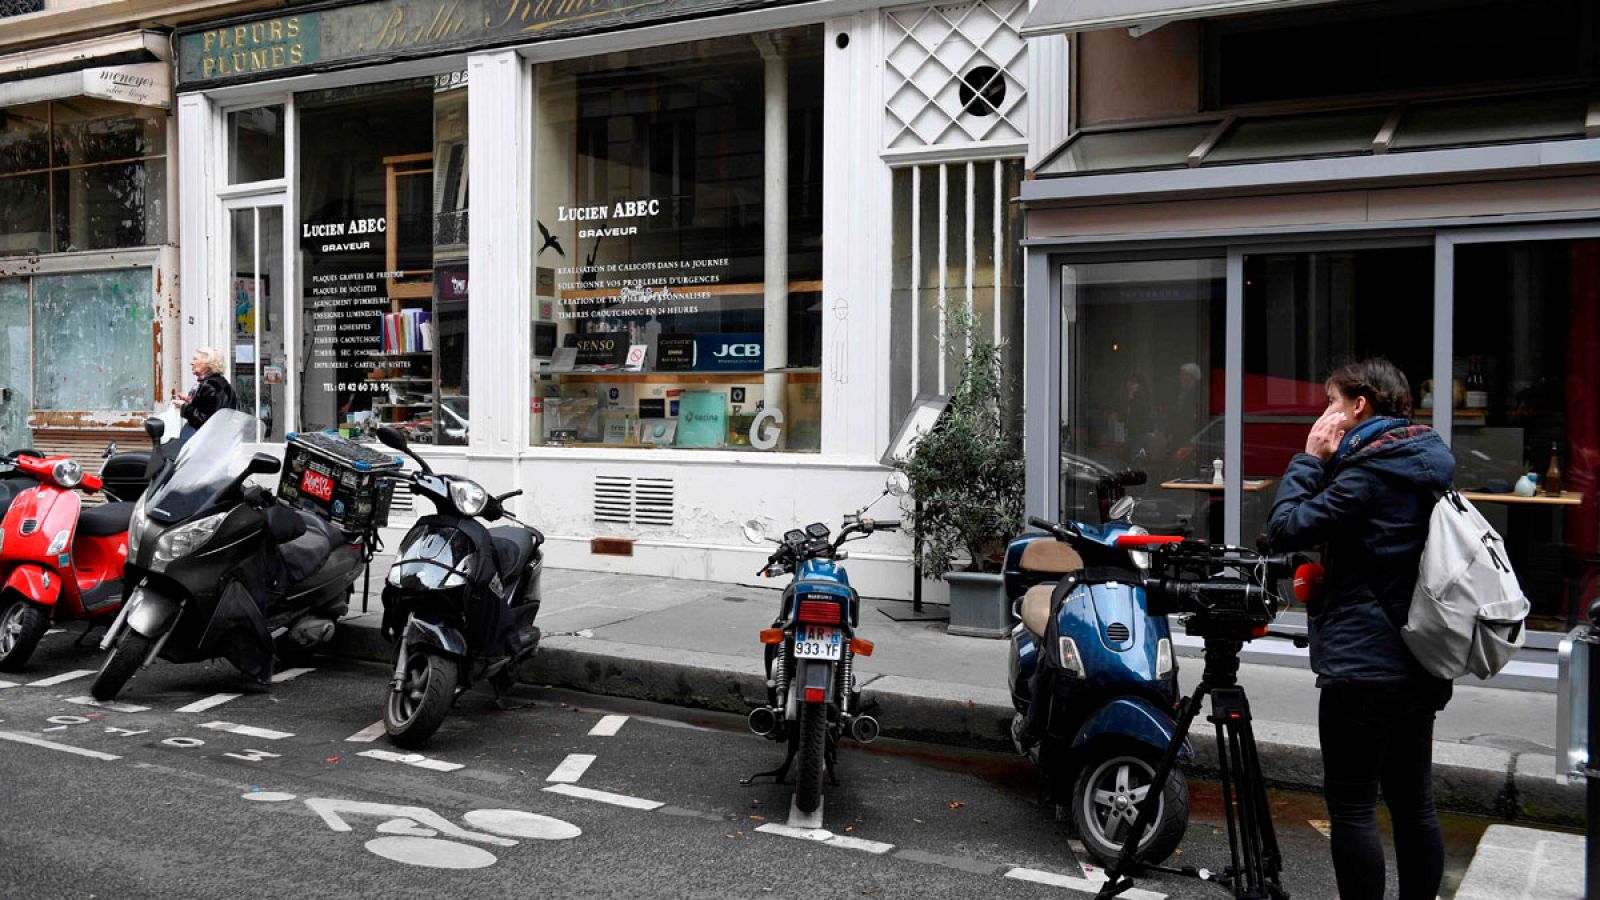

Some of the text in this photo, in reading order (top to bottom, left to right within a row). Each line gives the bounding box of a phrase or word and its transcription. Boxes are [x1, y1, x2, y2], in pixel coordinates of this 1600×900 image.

[204, 16, 300, 51] FLEURS
[203, 44, 304, 79] PLUMES
[612, 199, 660, 218] ABEC
[348, 218, 386, 234] ABEC
[578, 226, 638, 239] GRAVEUR
[322, 241, 370, 252] GRAVEUR
[606, 264, 617, 272] DE
[618, 262, 656, 271] CALICOTS
[657, 260, 678, 269] DANS
[680, 260, 690, 268] LA
[366, 272, 375, 280] DE
[606, 279, 621, 288] VOS
[646, 307, 657, 316] EN
[667, 306, 698, 314] HEURES
[576, 339, 615, 351] SENSO
[712, 343, 761, 357] JCB
[338, 383, 346, 392] 01
[348, 383, 357, 392] 42
[358, 383, 368, 392] 60
[370, 383, 379, 392] 76
[380, 383, 390, 392] 95
[749, 407, 784, 450] G
